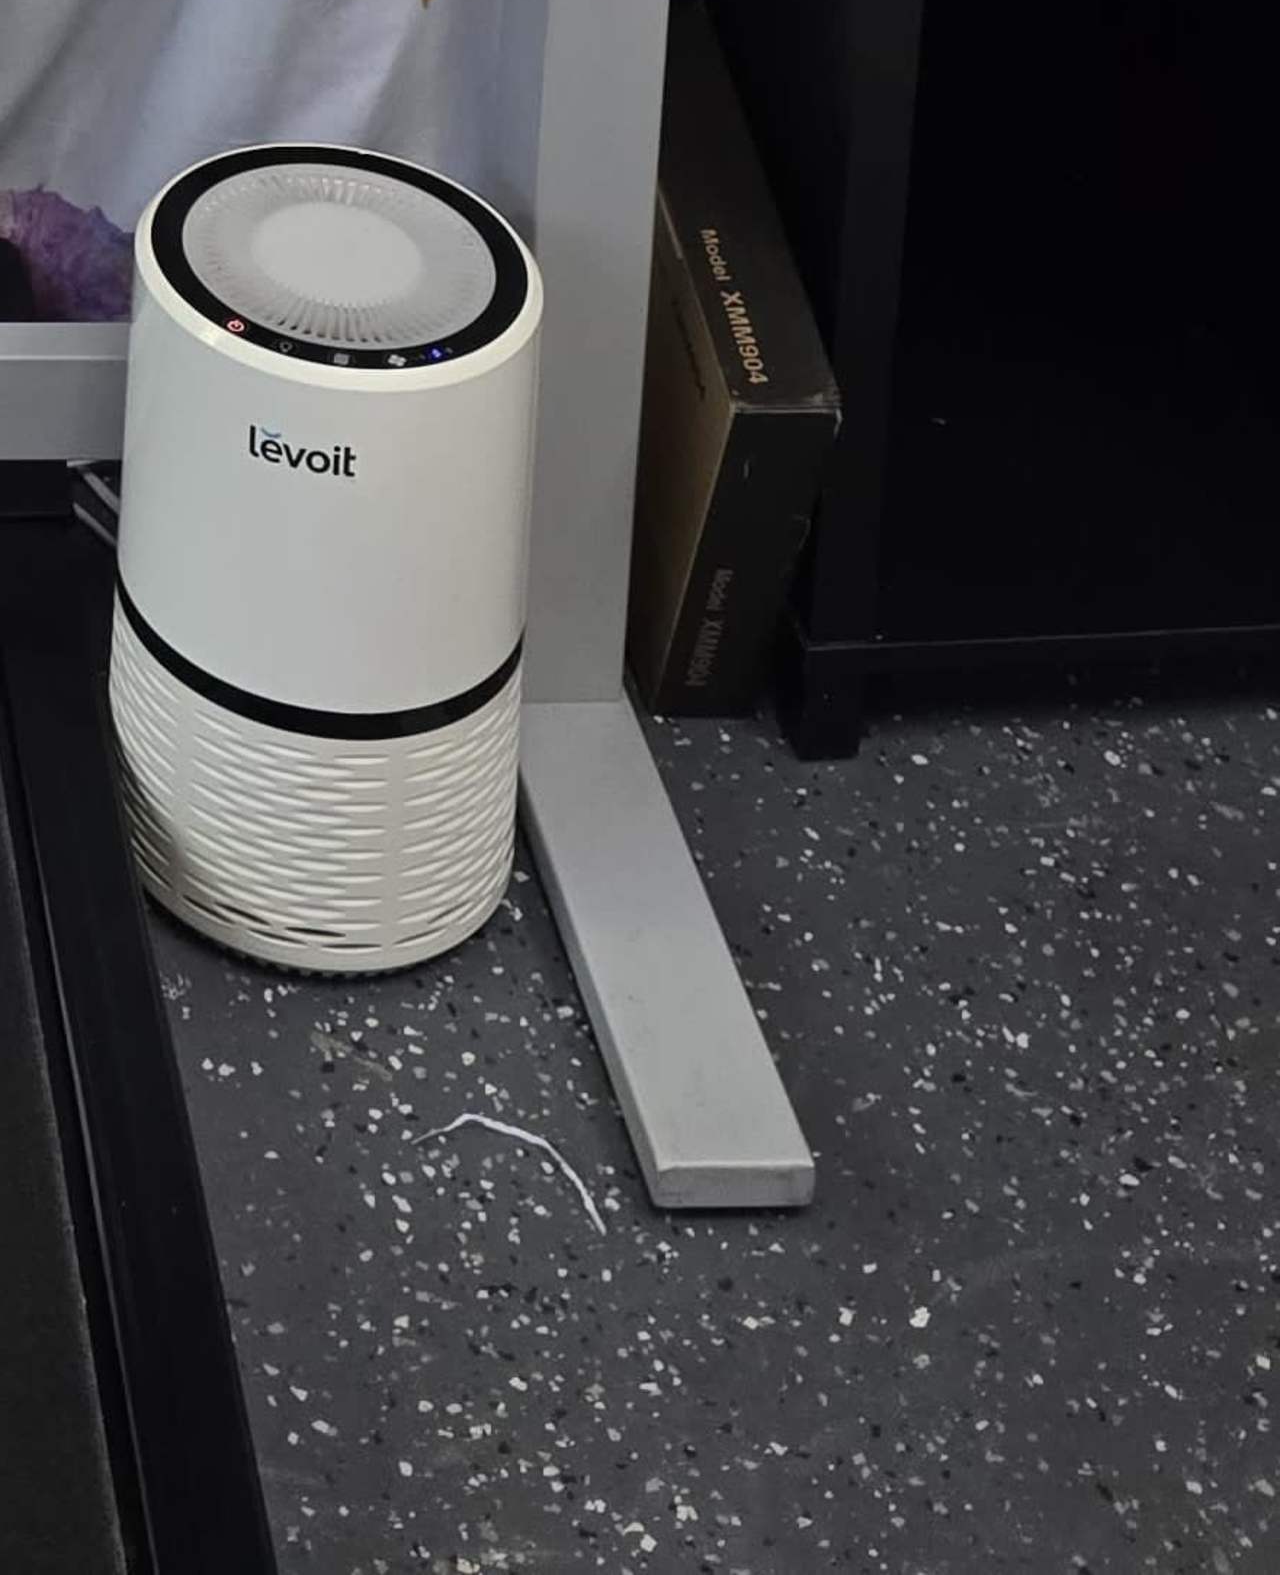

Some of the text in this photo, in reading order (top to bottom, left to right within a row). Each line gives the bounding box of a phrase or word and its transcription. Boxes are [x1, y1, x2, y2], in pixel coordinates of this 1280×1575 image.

[700, 227, 770, 386] Model XMM904
[704, 567, 734, 613] Model
